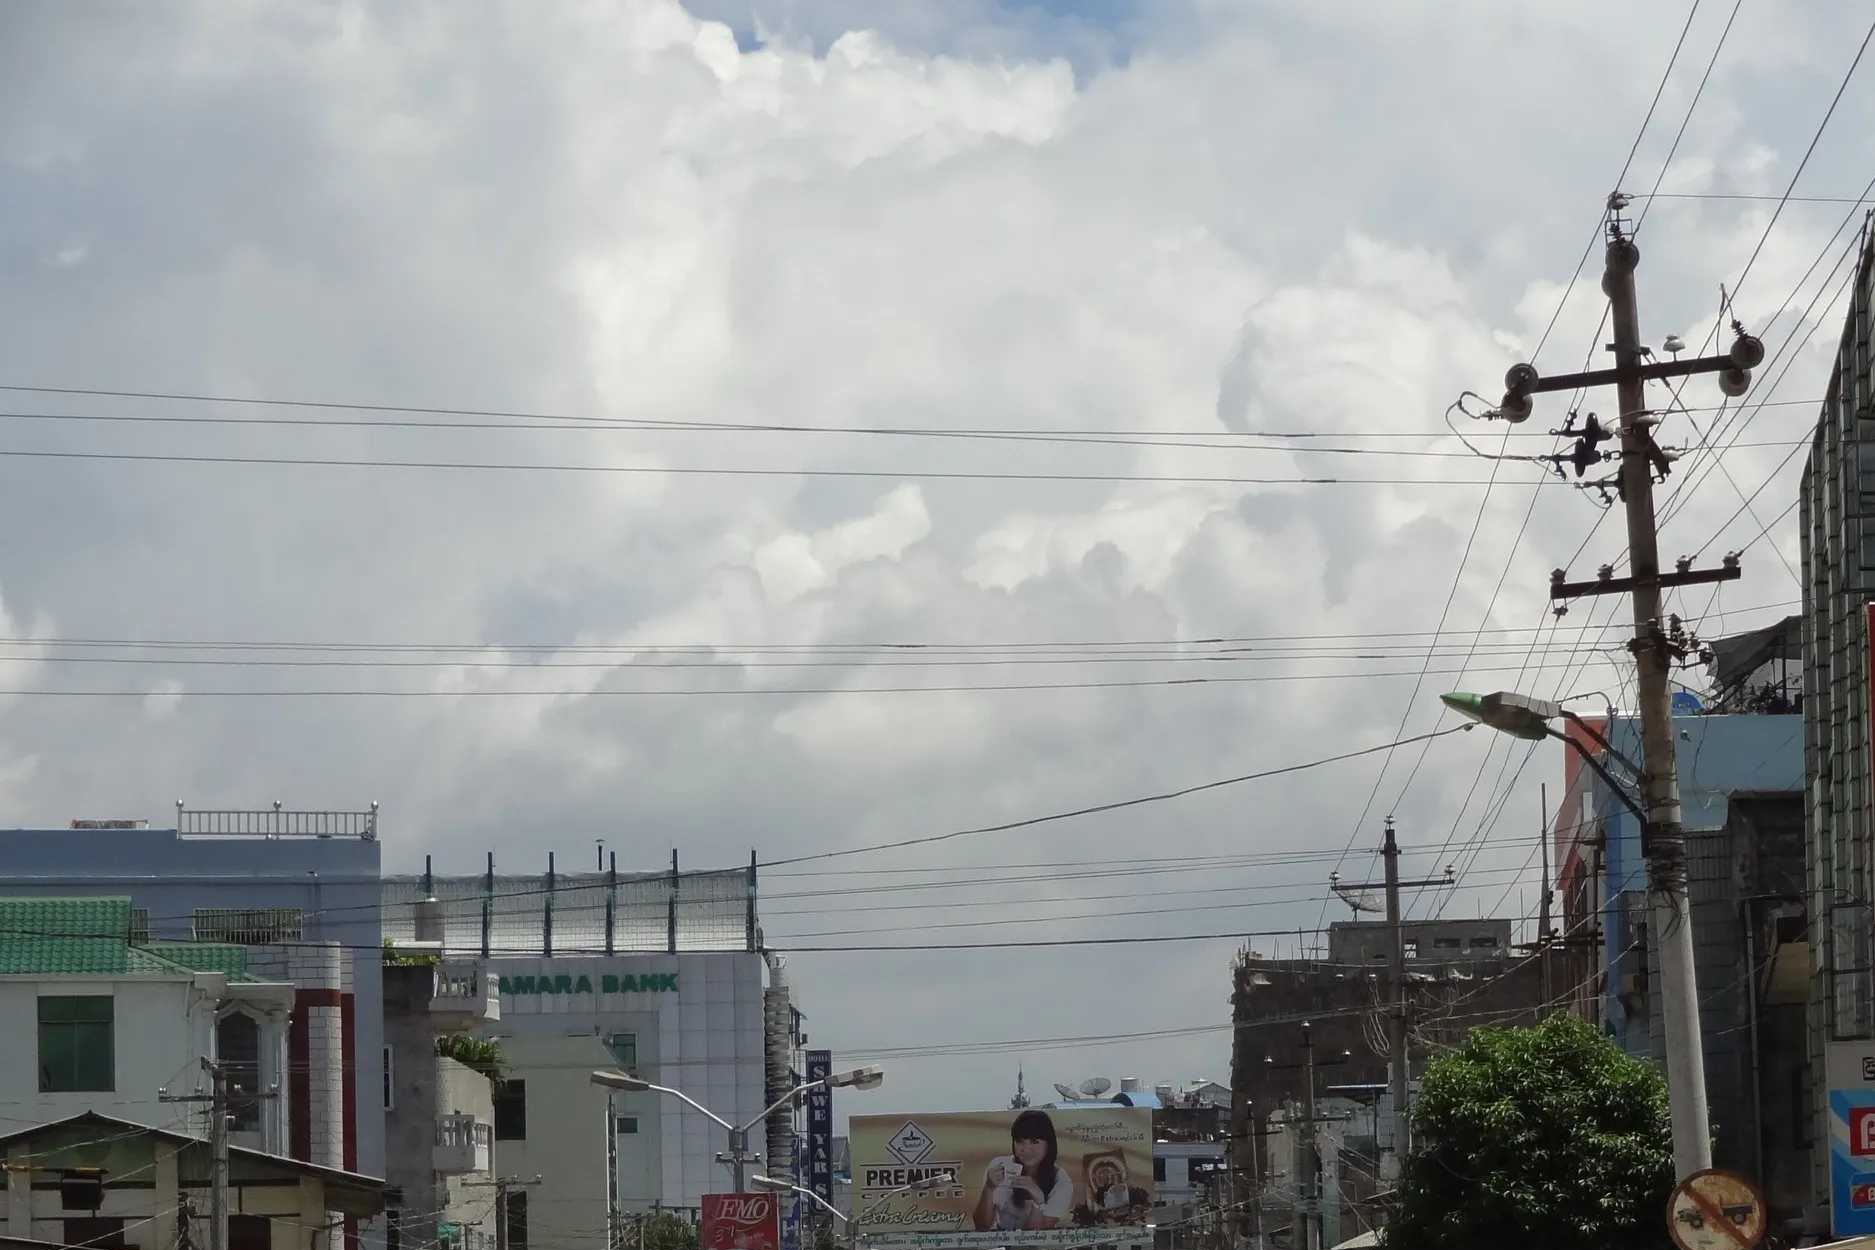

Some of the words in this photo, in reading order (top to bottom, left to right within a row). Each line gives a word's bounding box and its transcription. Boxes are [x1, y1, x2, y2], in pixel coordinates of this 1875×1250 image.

[499, 975, 593, 995] AMARA
[602, 973, 680, 994] BANK
[858, 1203, 901, 1226] Extra
[902, 1205, 966, 1229] Creamy
